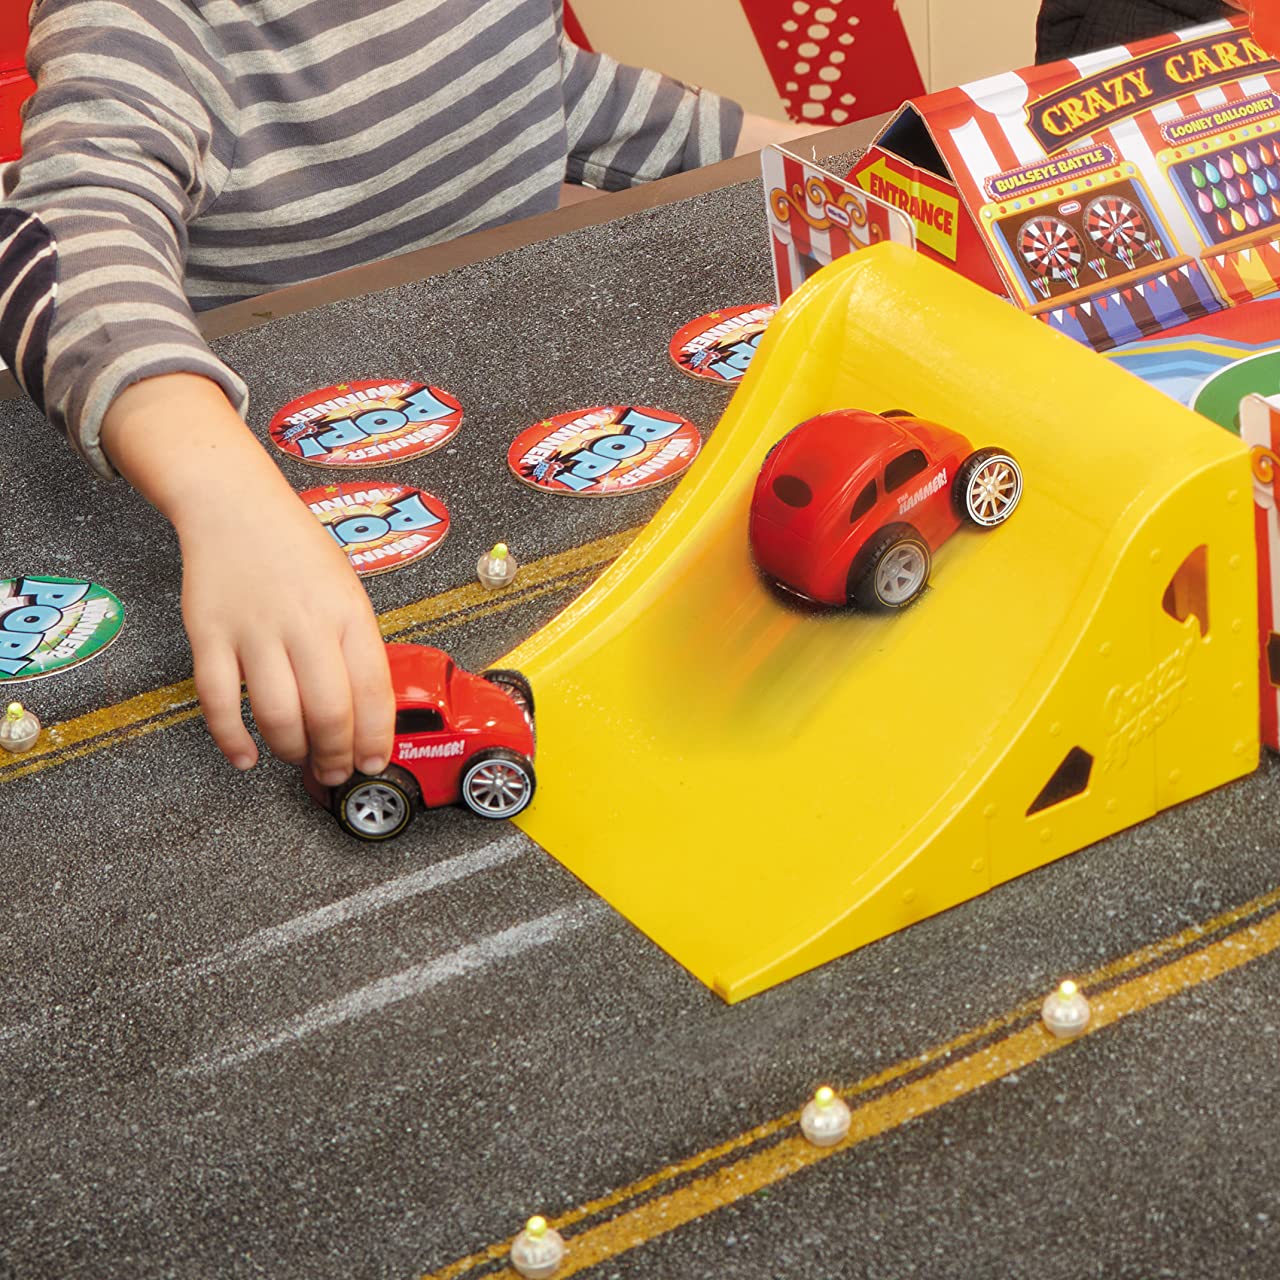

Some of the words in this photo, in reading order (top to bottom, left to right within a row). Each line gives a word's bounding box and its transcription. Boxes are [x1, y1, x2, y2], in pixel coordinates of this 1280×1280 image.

[1041, 67, 1153, 136] CRAZY
[1165, 37, 1271, 84] CARN
[1170, 116, 1213, 138] LOONEY
[1213, 98, 1274, 125] BALLOONEY
[994, 163, 1059, 193] BULLSEYE
[1057, 149, 1105, 173] BATTLE
[870, 172, 953, 236] ENTRANCE
[709, 333, 764, 380] P!
[283, 384, 397, 424] WINNER
[298, 386, 458, 458] POP!
[554, 407, 684, 491] POP!
[308, 488, 384, 516] WINN
[898, 468, 948, 515] HAMMER!
[323, 494, 443, 547] PO
[352, 533, 432, 566] WINN
[399, 740, 465, 759] HAMMER!
